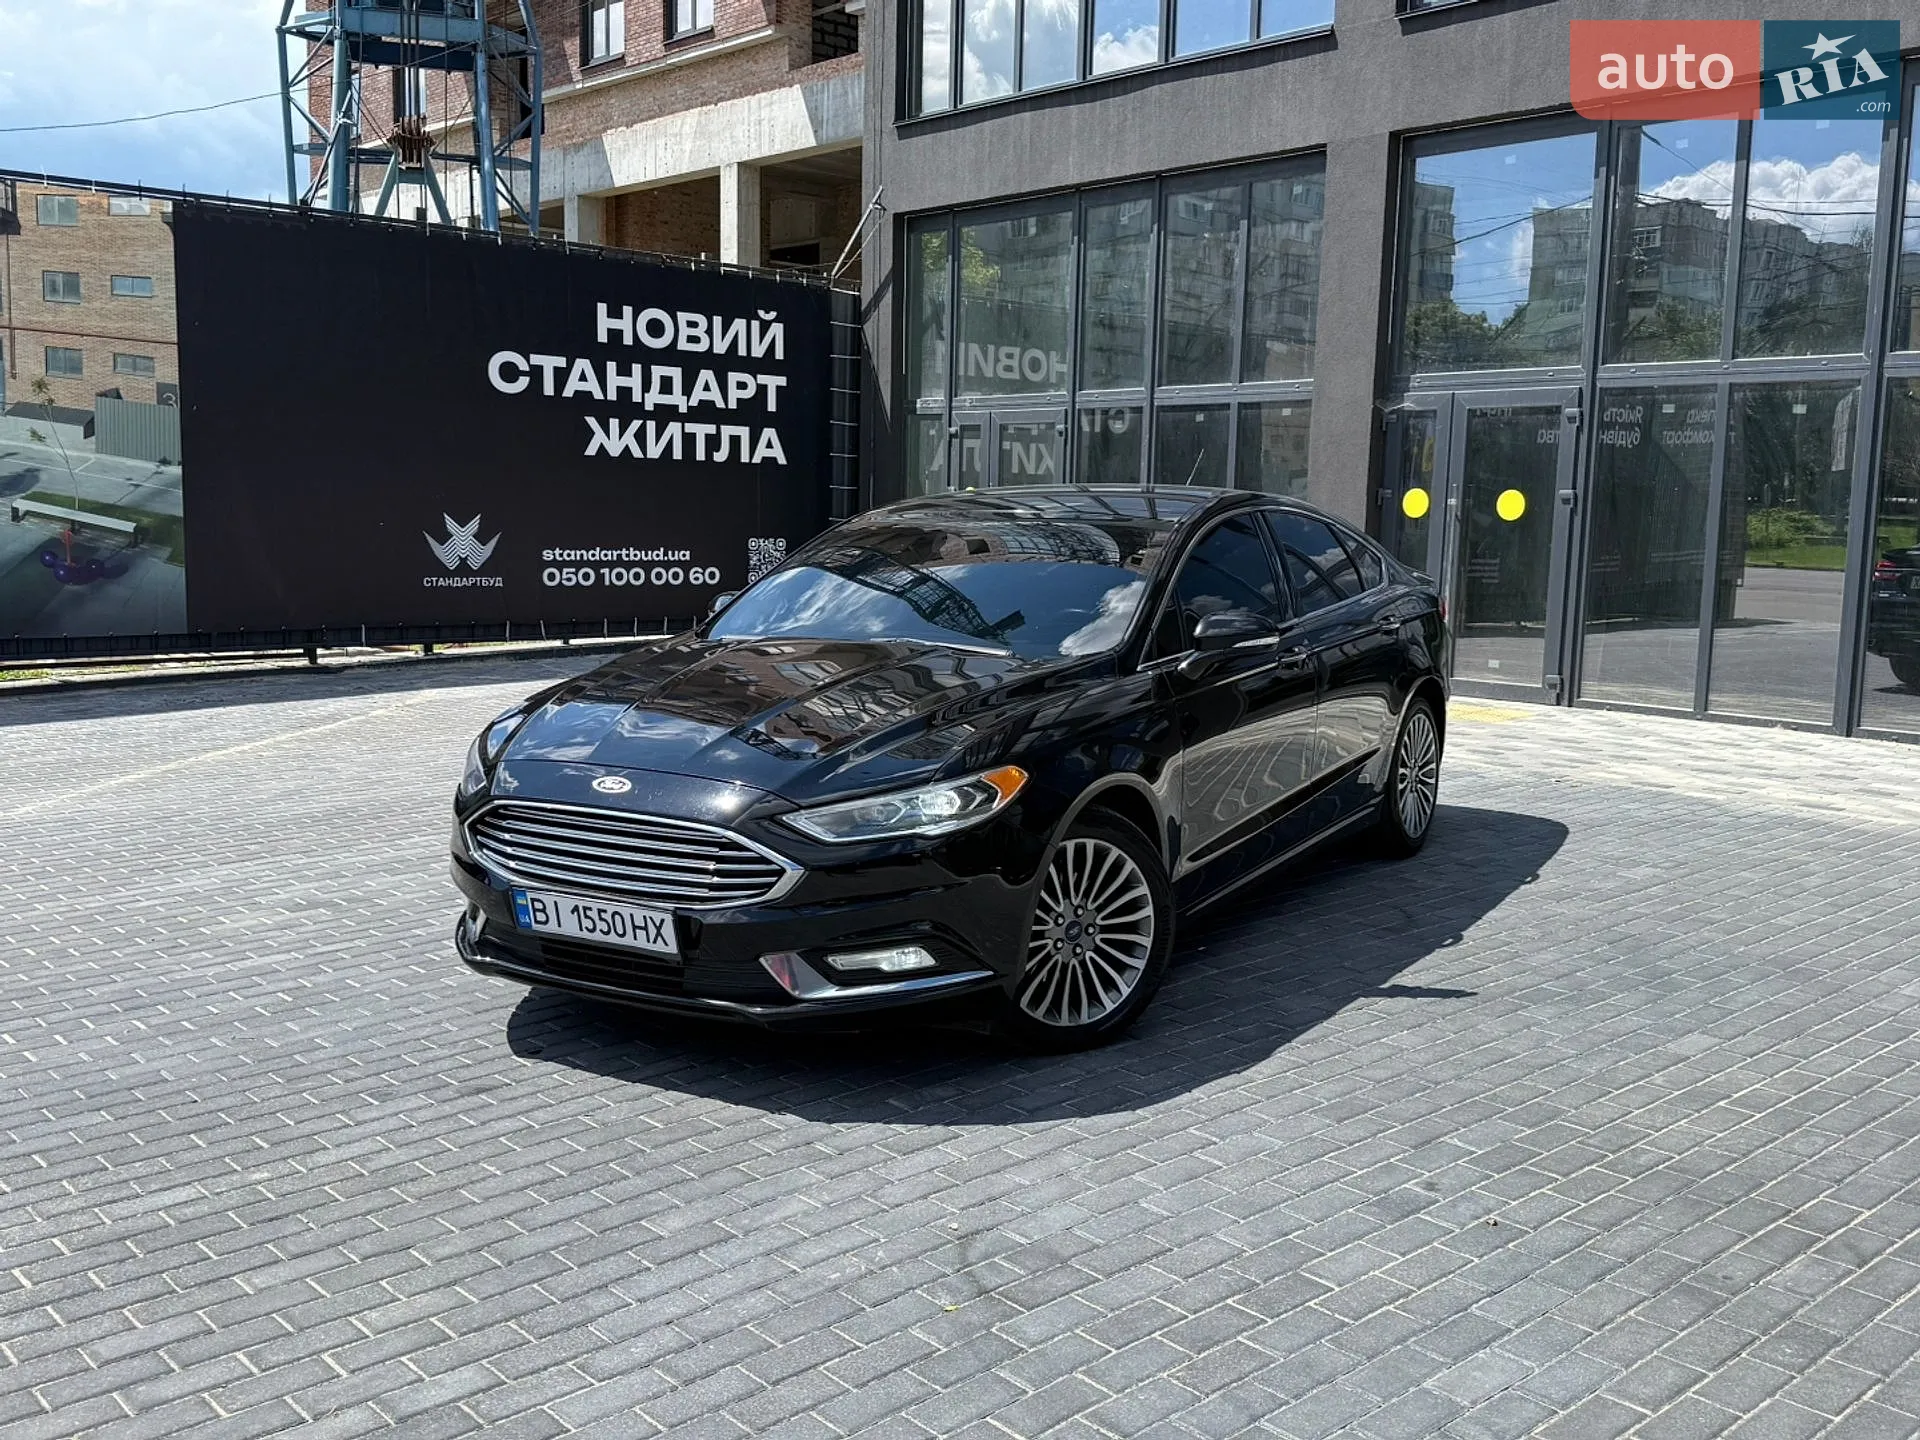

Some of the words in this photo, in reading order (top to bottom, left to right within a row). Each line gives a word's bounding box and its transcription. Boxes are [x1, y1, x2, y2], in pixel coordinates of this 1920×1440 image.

[596, 302, 785, 360] НОВИЙ
[487, 350, 787, 413] СТАНДАРТ
[583, 416, 788, 465] ЖИТЛА
[541, 547, 691, 562] standartbud.ua
[423, 576, 504, 588] СТАНДАРТБУД
[542, 568, 596, 587] 050
[600, 567, 646, 587] 100
[650, 567, 685, 586] 00
[689, 567, 721, 585] 60
